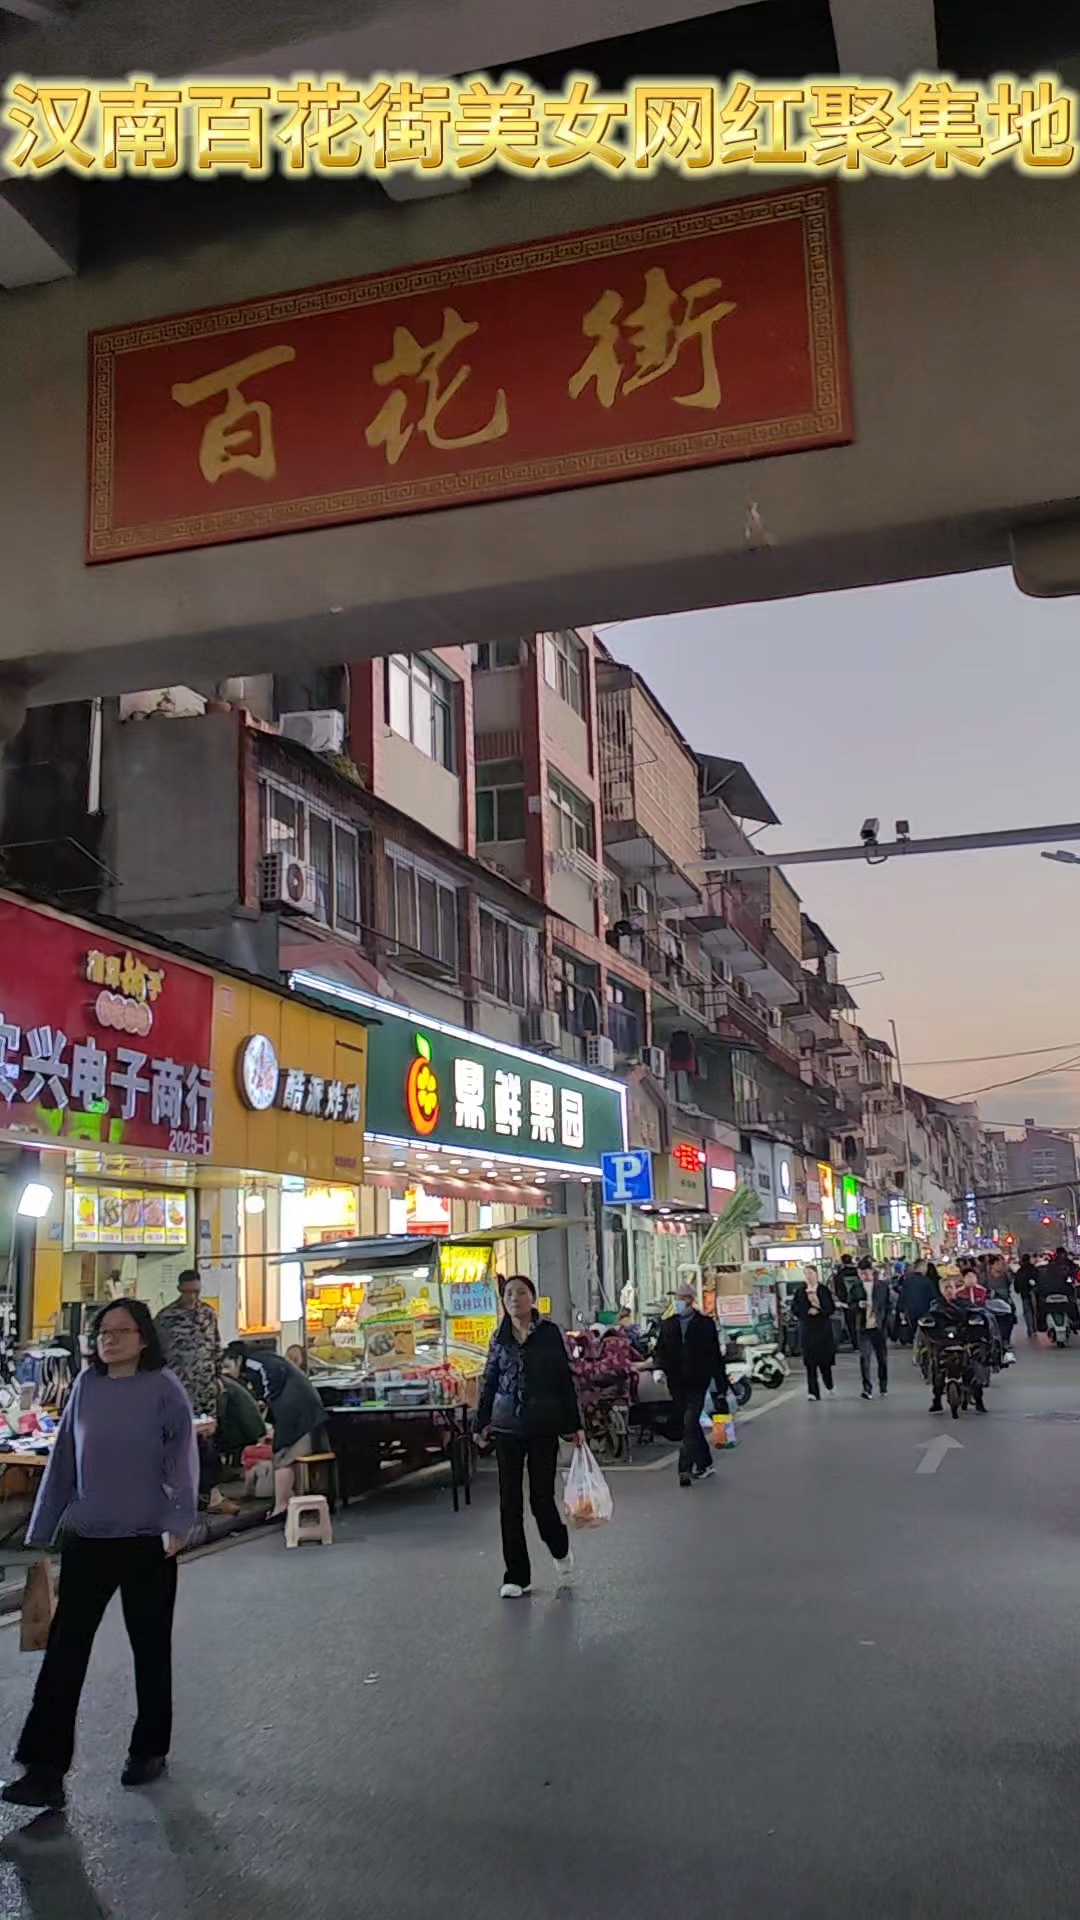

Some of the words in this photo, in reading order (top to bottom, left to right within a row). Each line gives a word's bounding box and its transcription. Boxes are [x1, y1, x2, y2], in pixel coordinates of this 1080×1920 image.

[172, 267, 736, 484] 百花街
[611, 1155, 642, 1199] P
